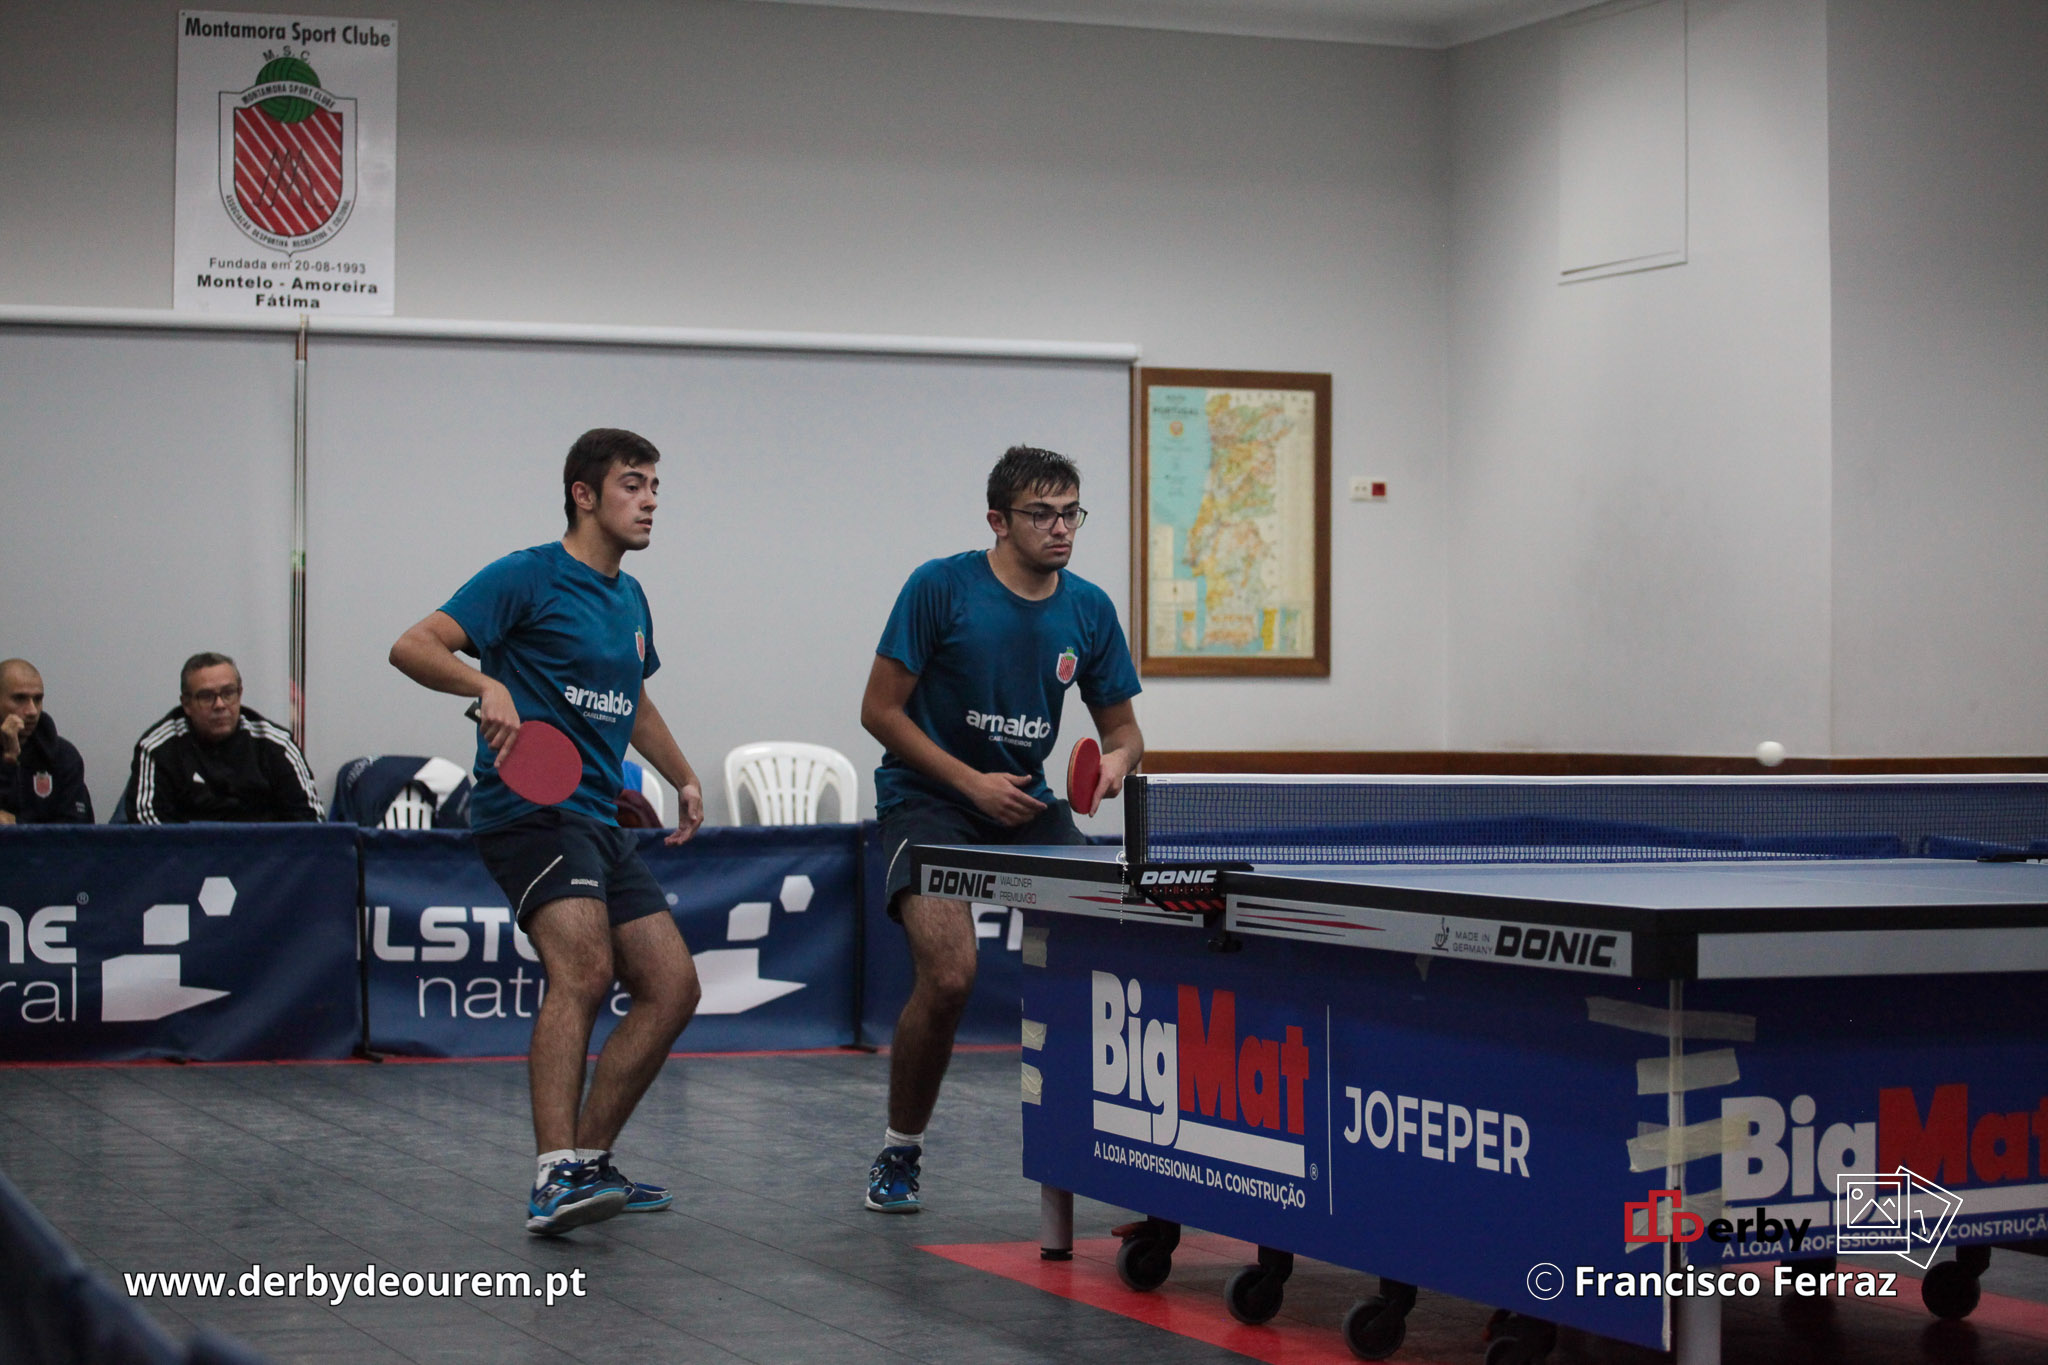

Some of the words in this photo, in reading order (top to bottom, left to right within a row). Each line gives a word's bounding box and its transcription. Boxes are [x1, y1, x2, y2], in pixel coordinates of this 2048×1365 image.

[185, 17, 286, 40] Montamora
[292, 21, 337, 46] Sport
[342, 26, 391, 48] Clube
[209, 257, 267, 270] Fundada
[271, 261, 291, 270] em
[295, 259, 366, 275] 20-08-1993
[197, 274, 273, 289] Montelo
[291, 277, 378, 294] Amoreira
[256, 293, 320, 309] Fátima
[564, 685, 634, 717] arnaldo
[965, 709, 1051, 740] arnaldo
[928, 868, 996, 900] DONIC
[1000, 874, 1032, 888] WALDNER
[1140, 869, 1218, 885] DONIC
[1453, 943, 1493, 955] GERMANY
[1455, 930, 1478, 941] MADE
[1482, 932, 1490, 943] IN
[1495, 925, 1617, 968] DONIC
[1092, 970, 1309, 1146] BigMat
[1344, 1086, 1530, 1178] JOFEPER
[1094, 1141, 1101, 1158] A
[1103, 1144, 1127, 1165] LOJA
[1129, 1149, 1204, 1184] PROFISSIONAL
[1206, 1168, 1223, 1189] DA
[1225, 1175, 1306, 1209] CONSTRUÇÃO
[1722, 1243, 1735, 1258] A
[1740, 1239, 1784, 1256] LOJA
[1947, 1213, 2048, 1240] CONSTRUÇÃ
